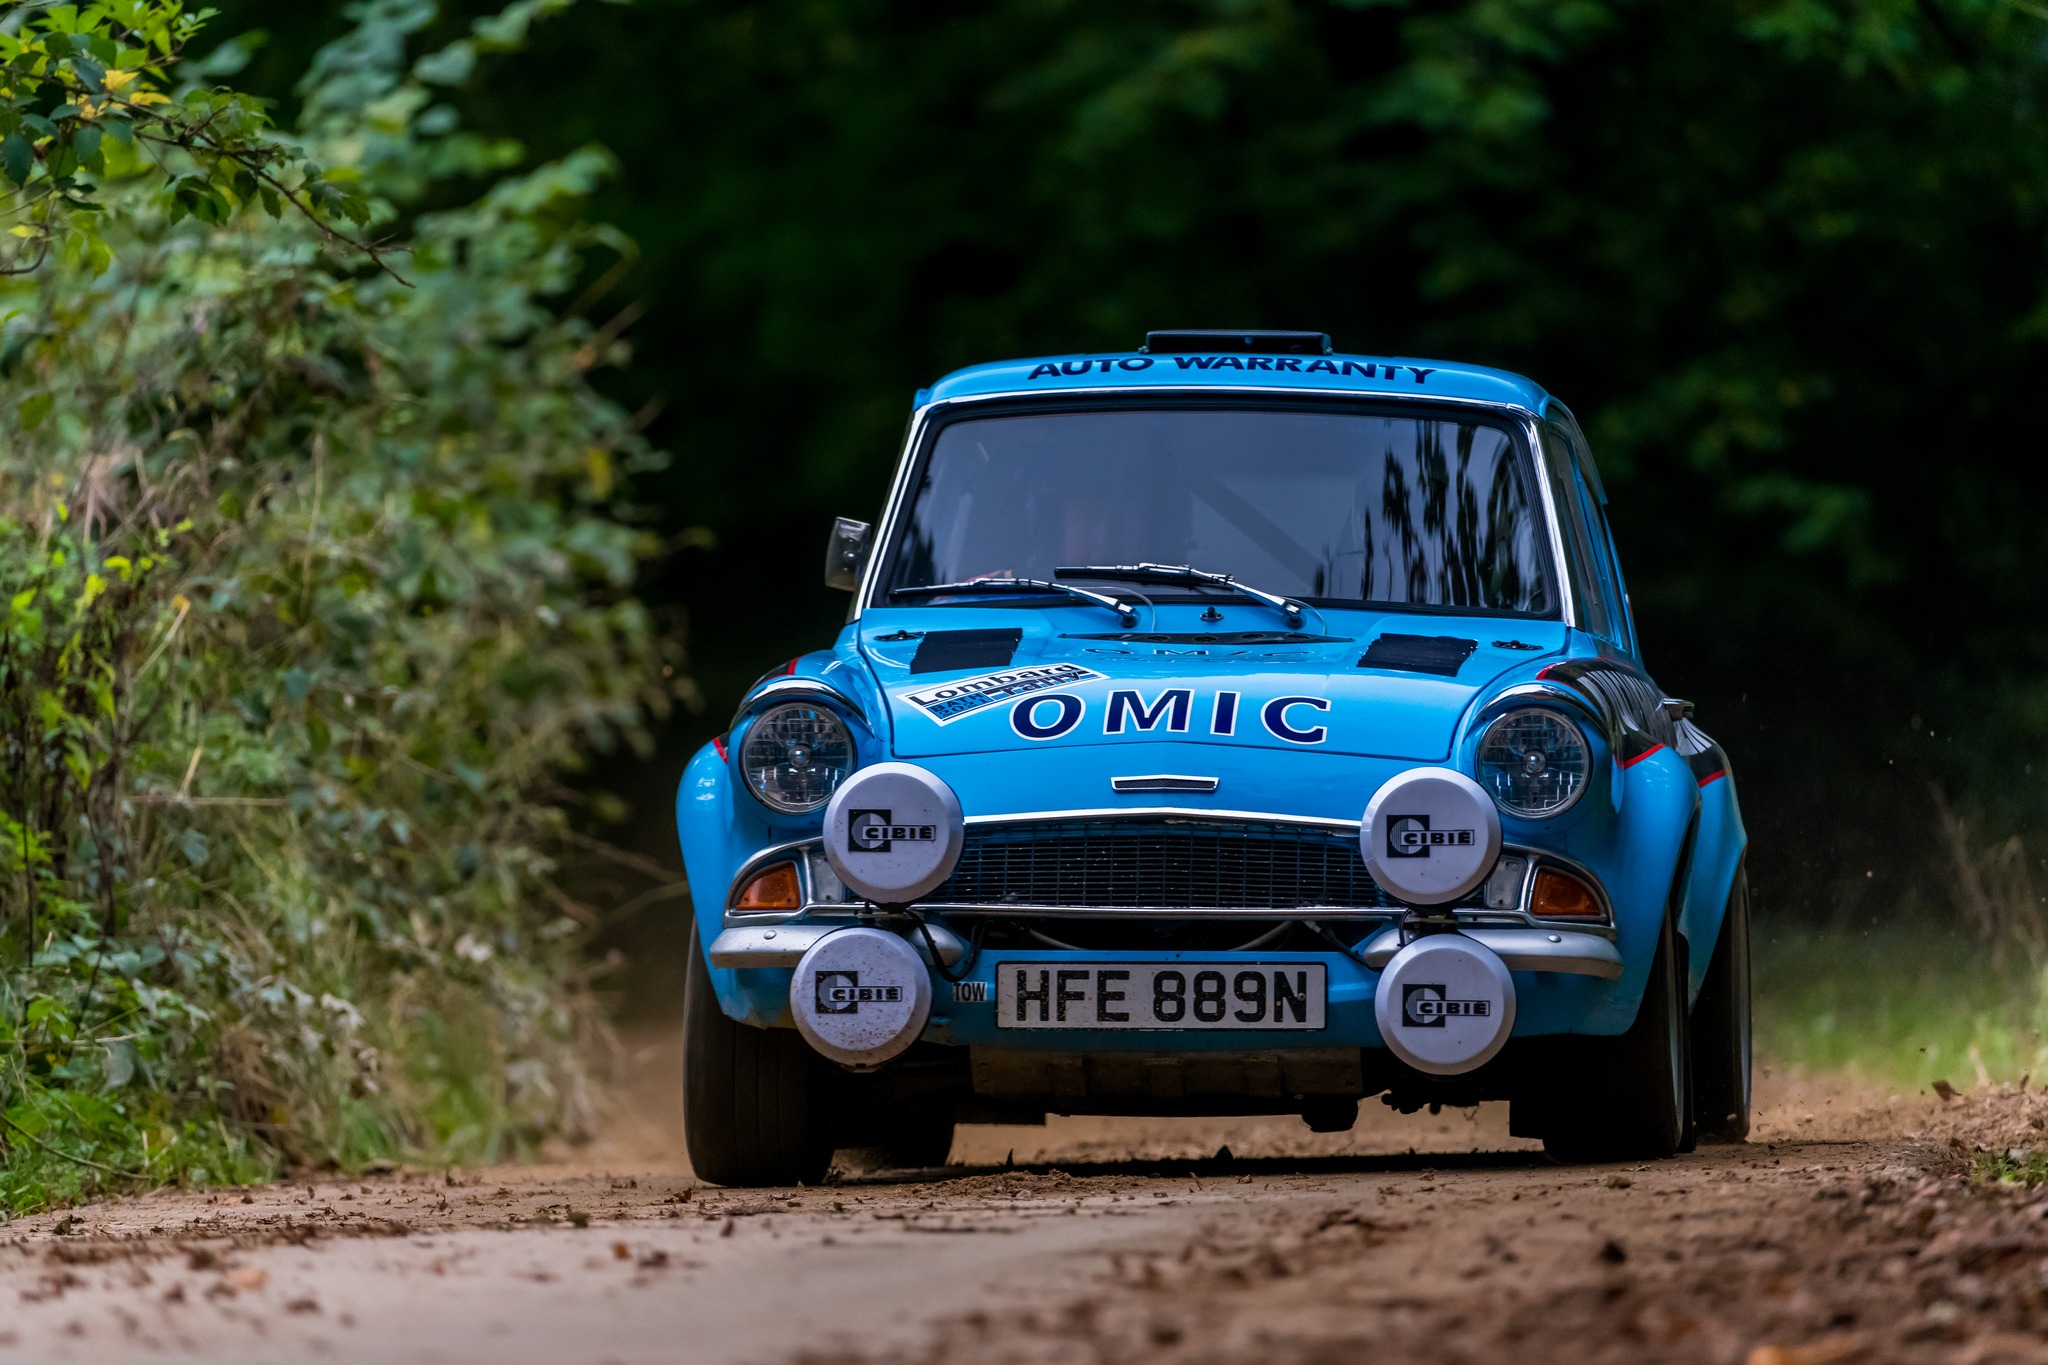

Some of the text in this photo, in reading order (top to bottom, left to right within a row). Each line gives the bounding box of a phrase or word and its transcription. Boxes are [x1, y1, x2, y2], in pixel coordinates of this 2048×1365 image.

[1027, 356, 1438, 385] AUTO WARRANTY
[908, 664, 1080, 706] Lombard
[1001, 671, 1081, 695] rally
[930, 692, 983, 712] BATH
[940, 698, 987, 718] 2021
[1009, 689, 1331, 744] OMIC
[953, 982, 985, 1001] TOW
[1016, 969, 1307, 1023] HFE 889N
